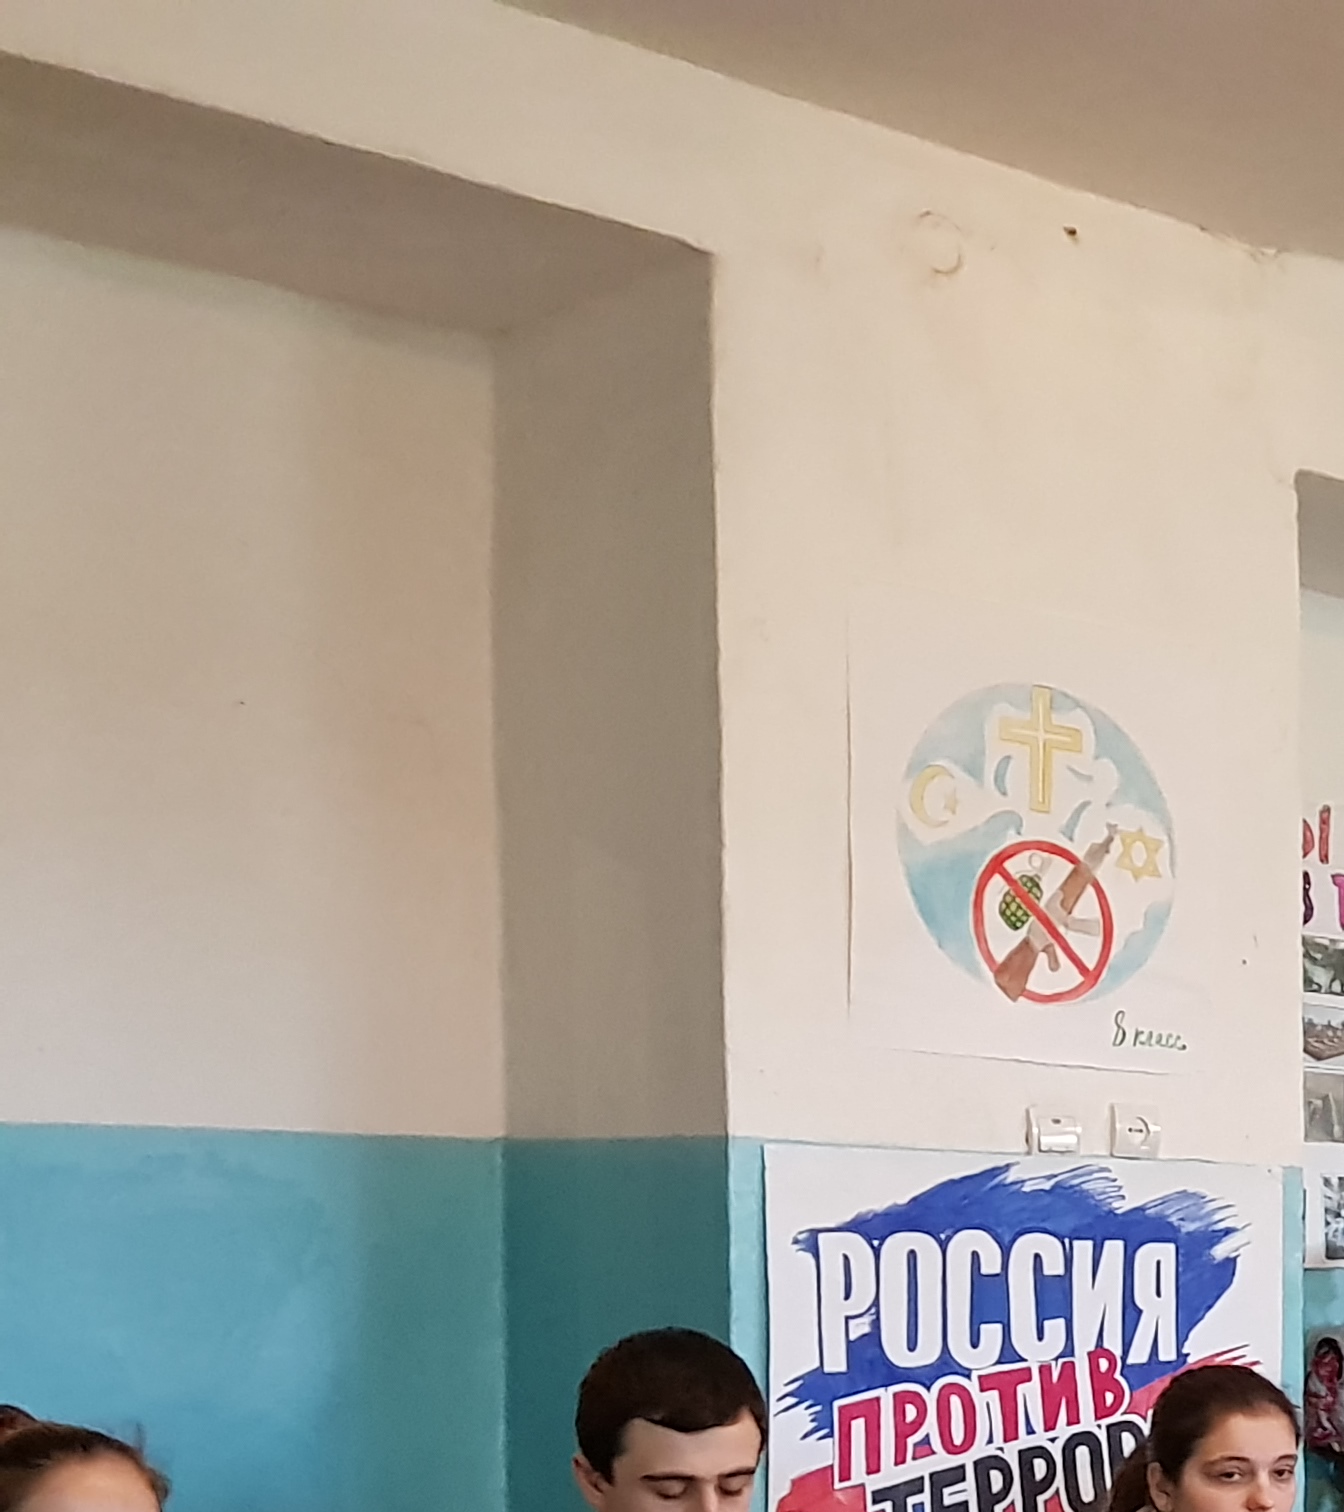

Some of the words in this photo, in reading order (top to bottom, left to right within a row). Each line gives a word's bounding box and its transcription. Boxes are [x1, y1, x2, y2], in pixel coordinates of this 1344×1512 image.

[1112, 1010, 1127, 1047] 8
[818, 1229, 1178, 1374] РОССИЯ
[836, 1347, 1128, 1484] ПРОТИВ
